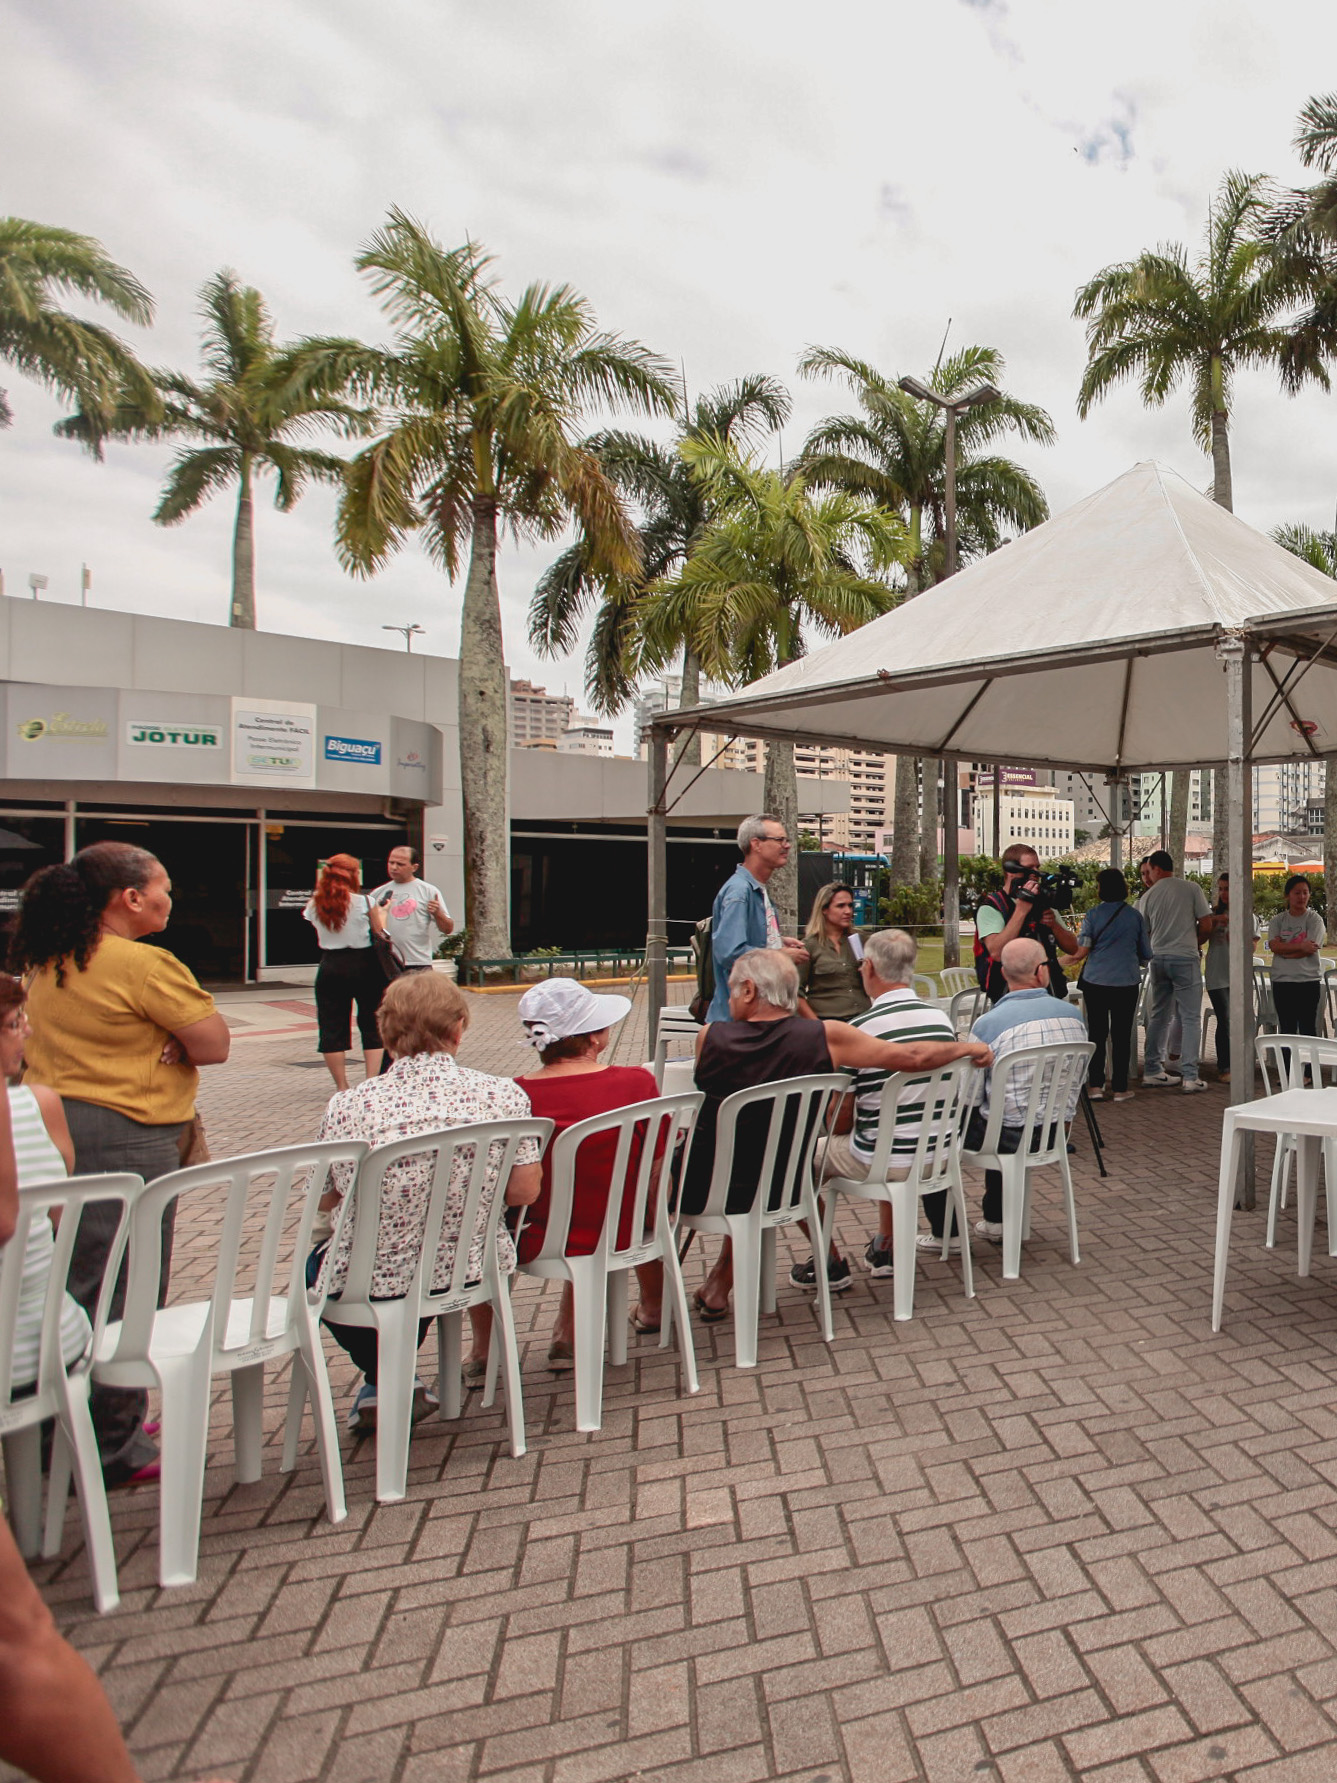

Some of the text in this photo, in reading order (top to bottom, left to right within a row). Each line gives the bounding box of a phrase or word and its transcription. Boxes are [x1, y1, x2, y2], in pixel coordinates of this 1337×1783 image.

[132, 730, 217, 746] JOTUR
[327, 739, 376, 756] Biguaçu
[1007, 773, 1033, 781] ESSENCIAL
